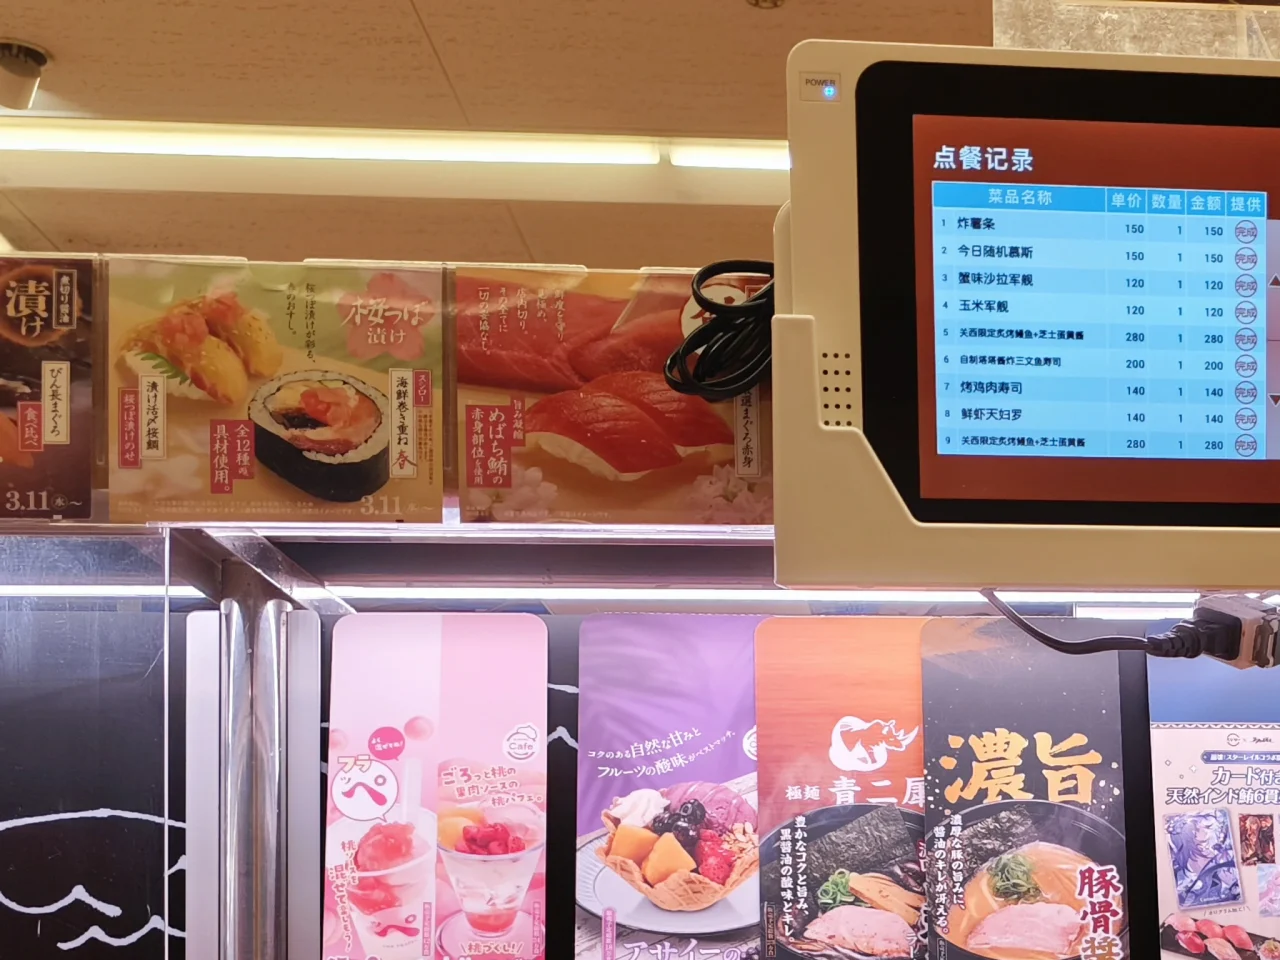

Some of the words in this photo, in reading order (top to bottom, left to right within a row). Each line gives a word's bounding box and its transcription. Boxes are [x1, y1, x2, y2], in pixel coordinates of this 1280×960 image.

[805, 79, 836, 87] POWER
[933, 145, 1033, 171] 点餐记录
[988, 188, 1053, 205] 菜品名称
[1111, 193, 1142, 209] 单价
[1152, 195, 1183, 210] 数量
[1190, 195, 1222, 211] 金额
[1230, 196, 1262, 212] 提供
[941, 219, 946, 227] 1
[957, 218, 996, 231] 炸薯条
[1125, 224, 1145, 235] 150
[1204, 226, 1224, 237] 150
[941, 246, 947, 255] 2
[1125, 251, 1145, 262] 150
[1204, 253, 1224, 264] 150
[941, 274, 947, 282] 3
[958, 272, 1034, 287] 蟹味沙拉军舰
[1125, 279, 1145, 289] 120
[1204, 280, 1224, 291] 120
[6, 280, 51, 337] 漬け
[341, 298, 429, 327] 桜つぼ
[942, 301, 948, 310] 4
[959, 299, 1009, 314] 玉米军舰
[1125, 305, 1145, 316] 120
[1204, 307, 1224, 318] 120
[367, 327, 407, 345] 漬け
[943, 328, 948, 337] 5
[1125, 332, 1145, 343] 280
[1204, 333, 1224, 344] 280
[943, 355, 949, 364] 6
[1125, 359, 1145, 370] 200
[1204, 361, 1224, 372] 200
[49, 368, 63, 437] びん長まぐろ
[944, 383, 950, 392] 7
[960, 381, 1023, 395] 烤鸡肉寿司
[1125, 386, 1145, 397] 140
[1204, 387, 1224, 399] 140
[24, 407, 39, 446] 食べ比べ
[944, 409, 950, 418] 8
[961, 408, 1022, 422] 鲜虾天妇罗
[1125, 412, 1145, 423] 140
[1204, 414, 1224, 425] 140
[487, 407, 507, 484] めばち鮪の
[945, 436, 950, 445] 9
[1125, 439, 1145, 450] 280
[1204, 440, 1224, 451] 280
[213, 425, 230, 492] 具材使用。
[508, 742, 534, 751] Cafe
[588, 727, 702, 759] コクのある自然な甘みと
[939, 727, 1103, 805] 濃旨
[794, 816, 809, 916] 豊かなコクと旨み、
[950, 814, 966, 910] 濃厚な豚の旨みに、
[780, 828, 796, 942] 黒醤油の酸味とキレ。
[933, 826, 950, 934] 醤油のキレが冴える。
